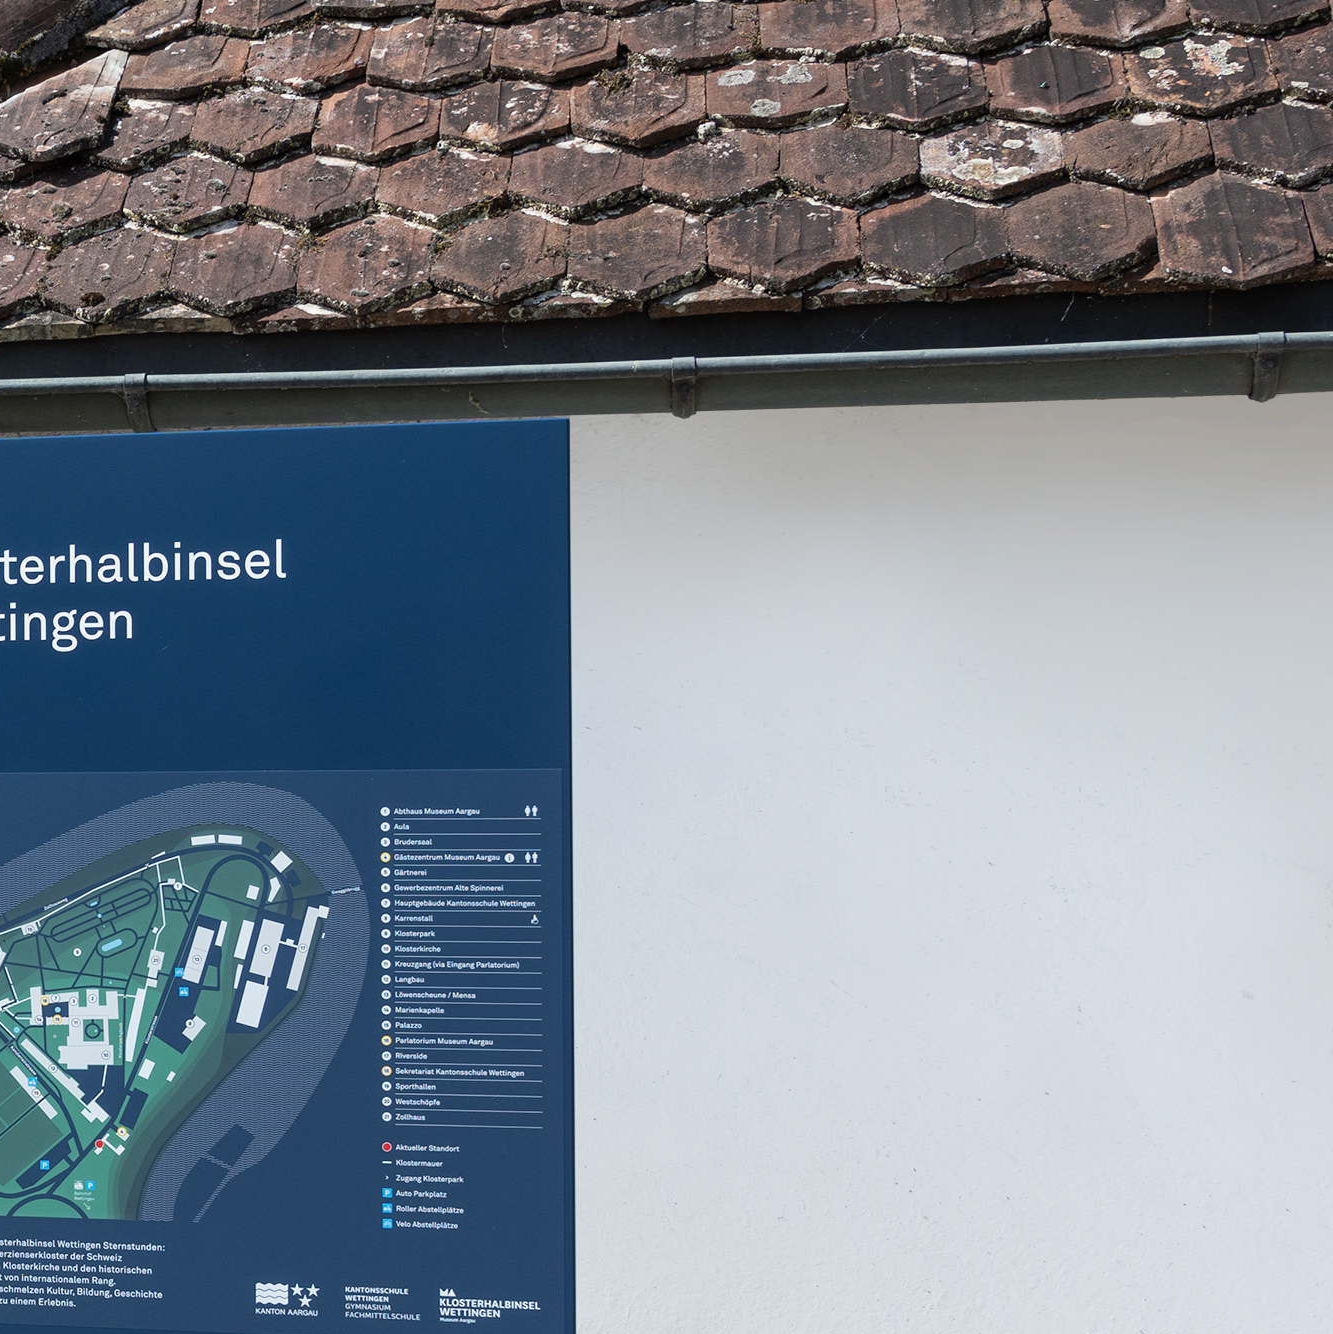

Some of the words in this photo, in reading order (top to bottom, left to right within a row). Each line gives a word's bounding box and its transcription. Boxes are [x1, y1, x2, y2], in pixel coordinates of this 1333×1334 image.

[455, 808, 480, 816] Aargau
[394, 838, 433, 846] Brudersaal
[393, 853, 443, 861] Gästezentrum
[475, 853, 501, 862] Aargau
[470, 884, 504, 893] Spinnerei
[394, 900, 446, 908] Hauptgebäude
[499, 900, 536, 909] Wettingen
[394, 930, 436, 938] Klosterpark
[394, 945, 441, 953] Klosterkirche
[394, 960, 432, 969] Kreuzgang
[432, 960, 446, 969] (via
[446, 960, 475, 970] Eingang
[475, 961, 520, 969] Parlatorium)
[394, 976, 425, 985] Langbau
[394, 991, 447, 999] Löwenscheune
[395, 1006, 445, 1015] Marienkapelle
[395, 1021, 423, 1029] Palazzo
[437, 1037, 468, 1045] Museum
[468, 1038, 494, 1047] Aargau
[395, 1052, 428, 1060] Riverside
[395, 1067, 435, 1075] Sekretariat
[435, 1068, 488, 1076] Kantonsschule
[488, 1069, 525, 1078] Wettingen
[395, 1082, 436, 1091] Sporthallen
[395, 1098, 441, 1107] Westschöpfe
[395, 1113, 426, 1121] Zollhaus
[395, 1144, 428, 1152] Aktueller
[428, 1144, 460, 1152] Standort
[395, 1159, 443, 1167] Klostermauer
[395, 1174, 422, 1184] Zugang
[422, 1175, 464, 1184] Klosterpark
[413, 1190, 447, 1199] Parkplatz
[396, 1205, 417, 1213] Roller
[417, 1206, 464, 1215] Abstellplätze
[395, 1220, 411, 1228] Velo
[412, 1221, 458, 1230] Abstellplätze
[57, 1240, 101, 1250] Wettingen
[103, 1241, 165, 1252] Sternstunden:
[70, 1252, 85, 1261] der
[86, 1252, 123, 1262] Schweiz
[3, 1261, 60, 1271] Klosterkirche
[61, 1264, 78, 1272] und
[80, 1264, 97, 1273] den
[98, 1264, 153, 1275] historischen
[21, 1273, 90, 1284] internationalem
[91, 1276, 116, 1287] Rang.
[46, 1286, 75, 1296] Kultur,
[76, 1287, 113, 1299] Bildung,
[113, 1289, 163, 1299] Geschichte
[345, 1286, 409, 1295] KANTONSSCHULE
[10, 1296, 36, 1305] einem
[38, 1297, 76, 1307] Erlebnis.
[345, 1294, 389, 1303] WETTINGEN
[345, 1303, 391, 1311] GYMNASIUM
[439, 1298, 541, 1310] KLOSTERHALBINSEL
[287, 1309, 318, 1317] AARGAU
[345, 1311, 420, 1321] FACHMITTELSCHULE
[439, 1307, 501, 1318] WETTINGEN
